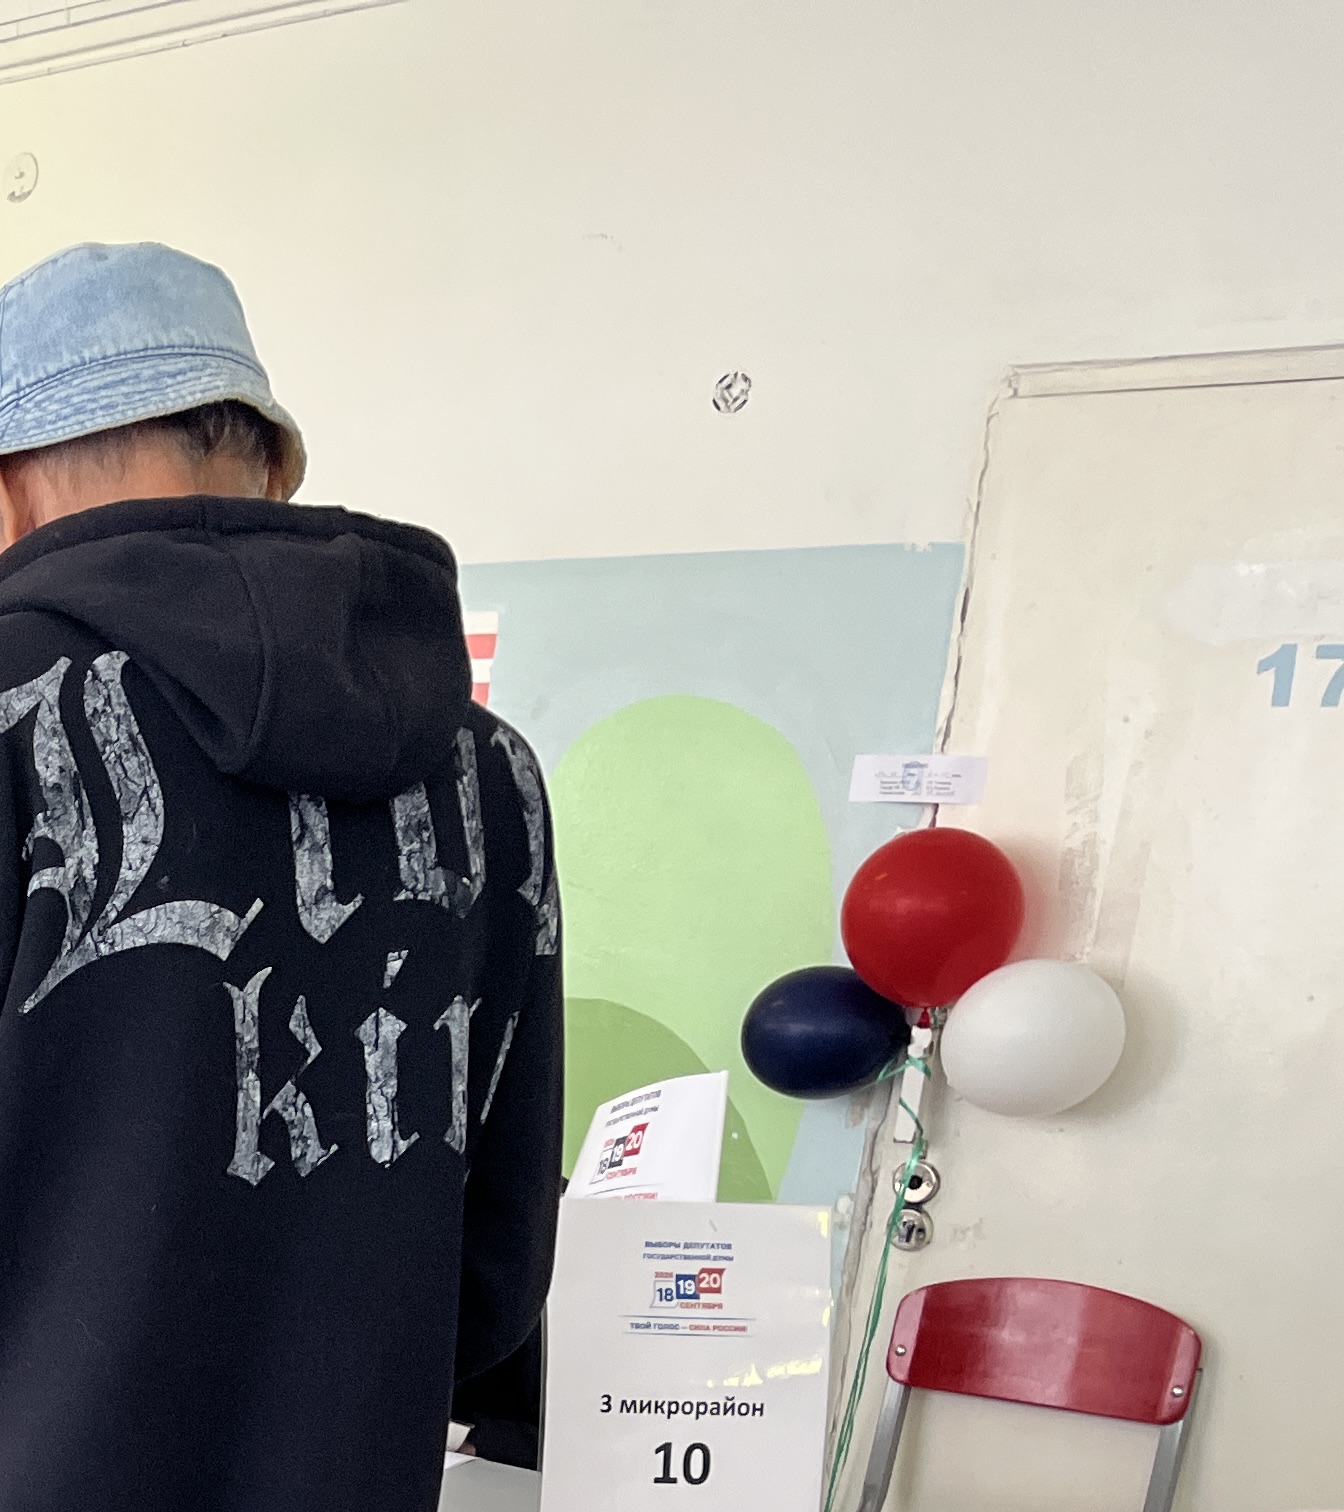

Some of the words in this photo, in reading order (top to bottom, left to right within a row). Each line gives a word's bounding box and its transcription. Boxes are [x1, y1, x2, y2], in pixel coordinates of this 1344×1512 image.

[625, 1131, 643, 1152] 20
[656, 1287, 674, 1302] 18
[677, 1279, 695, 1295] 19
[699, 1273, 721, 1289] 20
[600, 1394, 612, 1413] 3
[619, 1396, 764, 1420] микрорайон
[653, 1441, 711, 1485] 10
